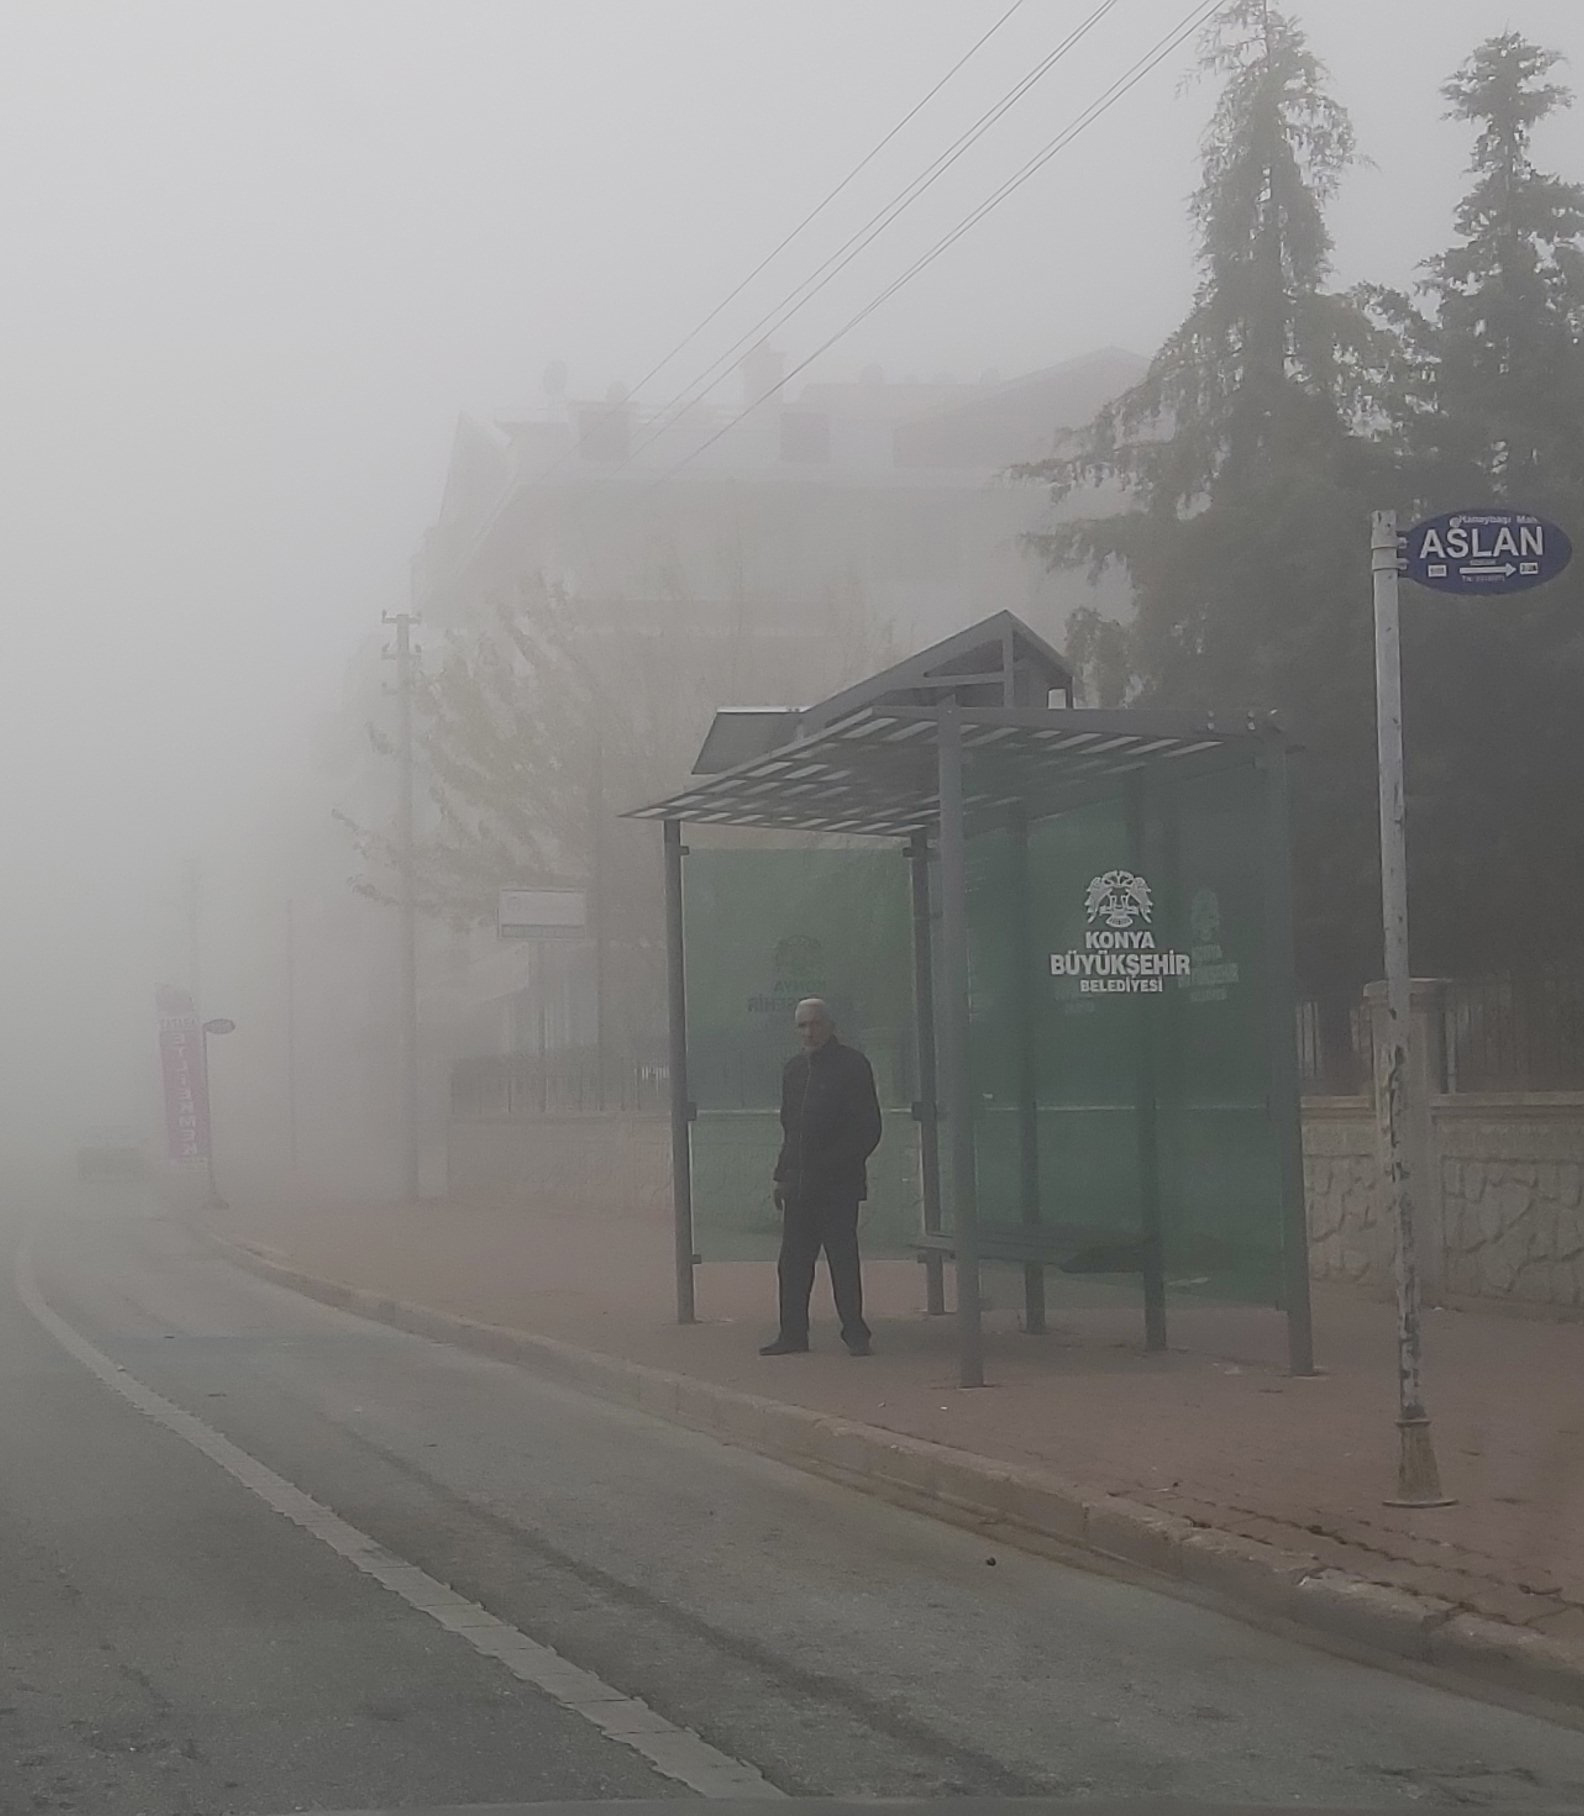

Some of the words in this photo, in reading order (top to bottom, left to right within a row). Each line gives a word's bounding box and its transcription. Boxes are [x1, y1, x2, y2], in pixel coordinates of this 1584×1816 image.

[1419, 526, 1544, 559] ASLAN
[1085, 931, 1156, 949] KONYA
[1050, 950, 1191, 978] BÜYÜKŞEHİR
[1080, 976, 1163, 992] BELEDİYESİ
